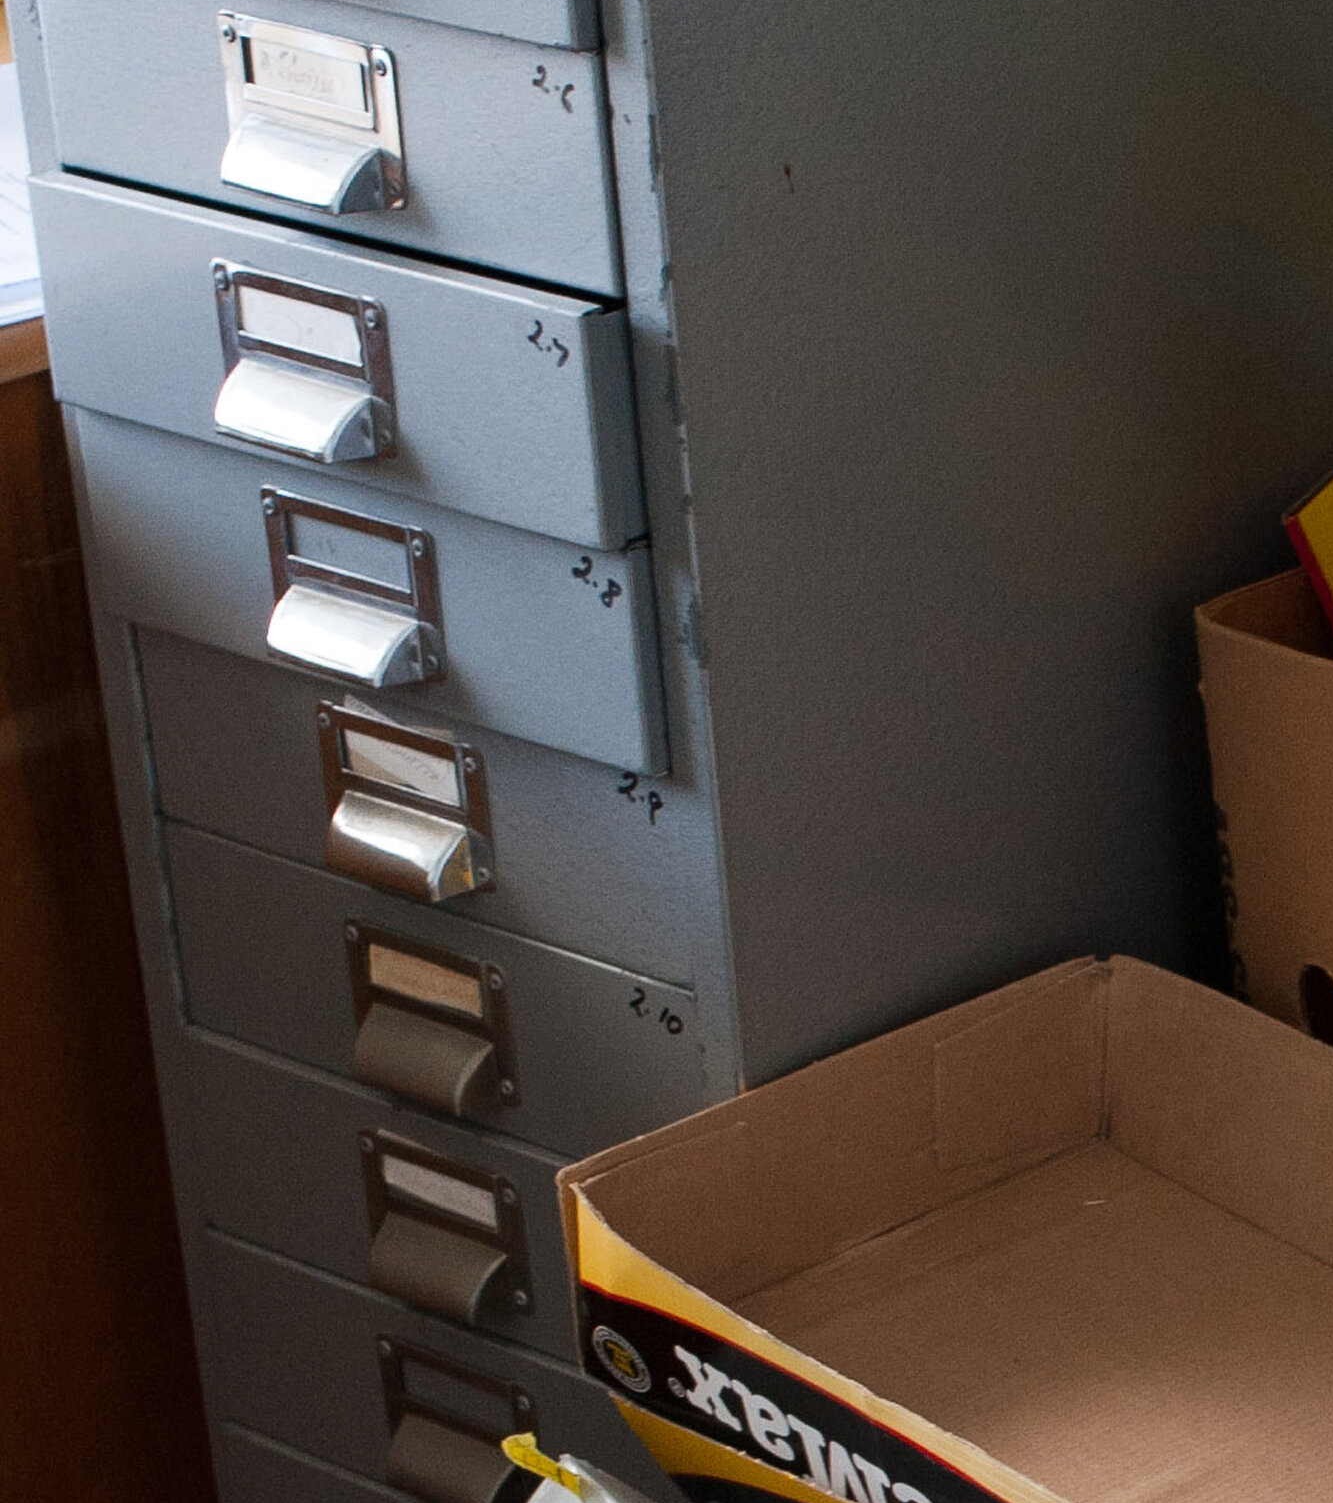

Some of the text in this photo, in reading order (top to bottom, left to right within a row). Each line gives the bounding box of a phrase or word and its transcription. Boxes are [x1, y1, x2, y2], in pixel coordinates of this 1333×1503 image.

[570, 555, 623, 609] 2.8
[617, 771, 664, 826] 2.9
[629, 988, 684, 1037] 2.10
